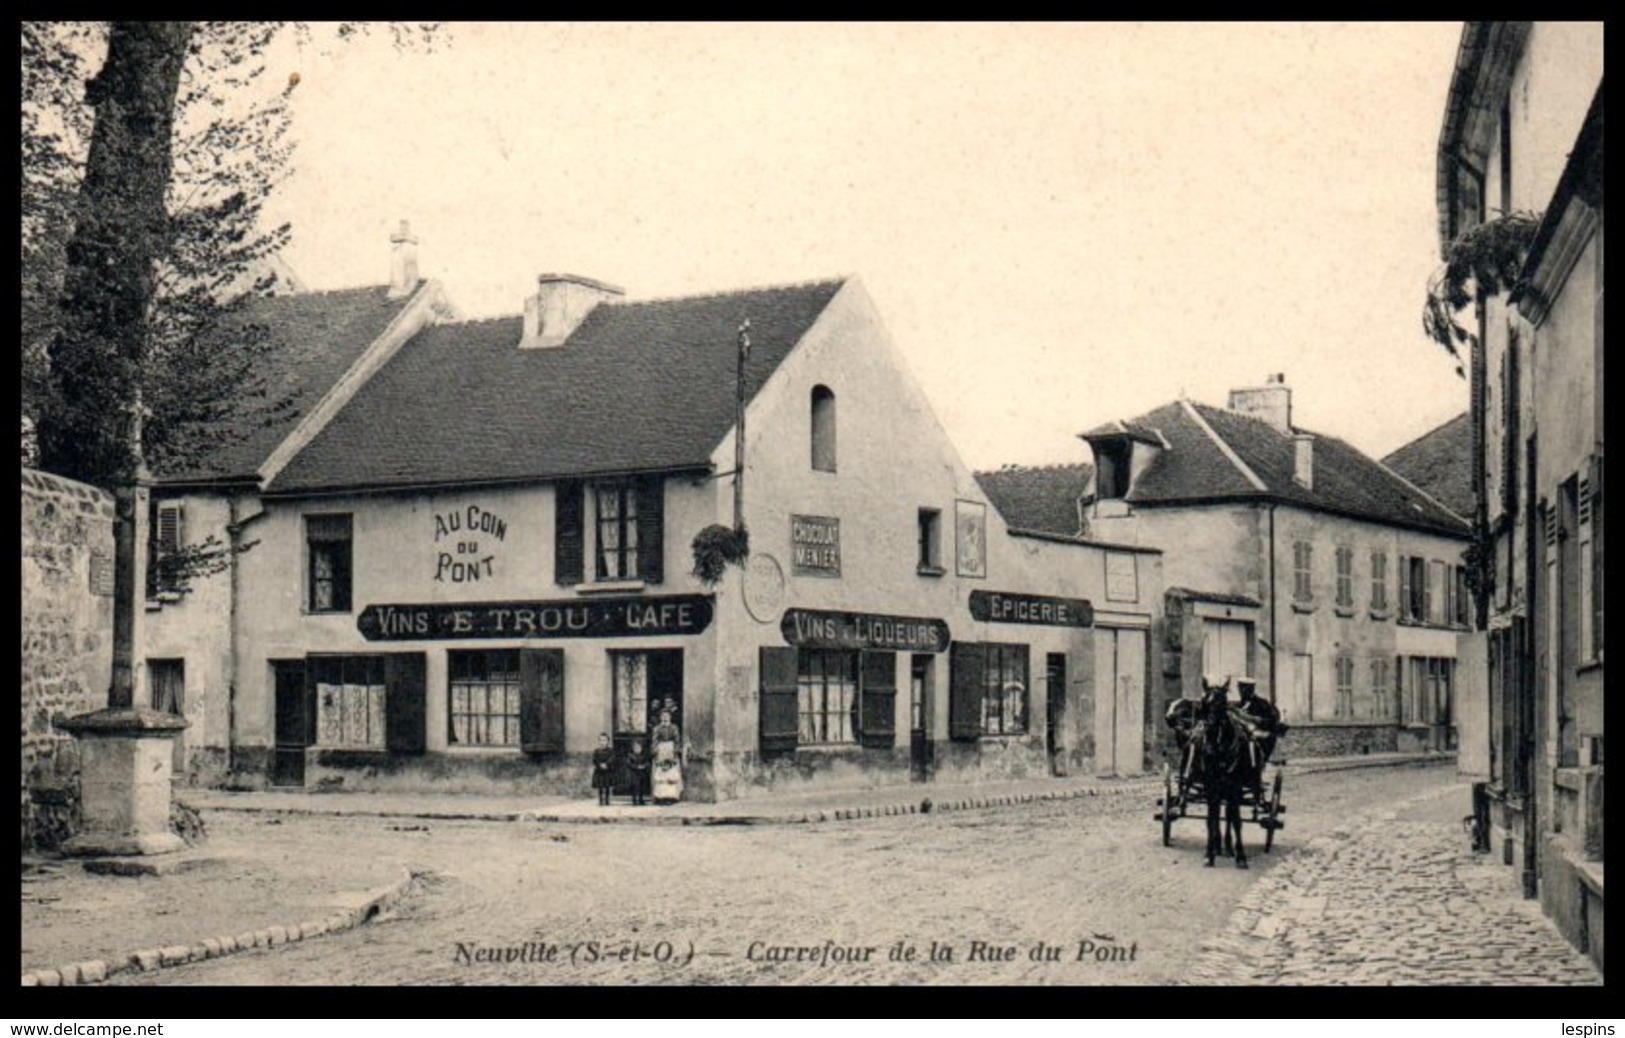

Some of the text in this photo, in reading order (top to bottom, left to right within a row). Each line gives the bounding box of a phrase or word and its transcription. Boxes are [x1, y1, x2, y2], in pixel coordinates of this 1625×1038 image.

[435, 505, 508, 542] AU COIN
[793, 522, 839, 545] CHOCOLAT
[434, 551, 495, 583] PONT
[795, 548, 839, 569] MENIER
[376, 607, 429, 636] VINS
[488, 606, 589, 631] TROU
[793, 611, 836, 643] VINS
[855, 617, 940, 645] LIQUEURS
